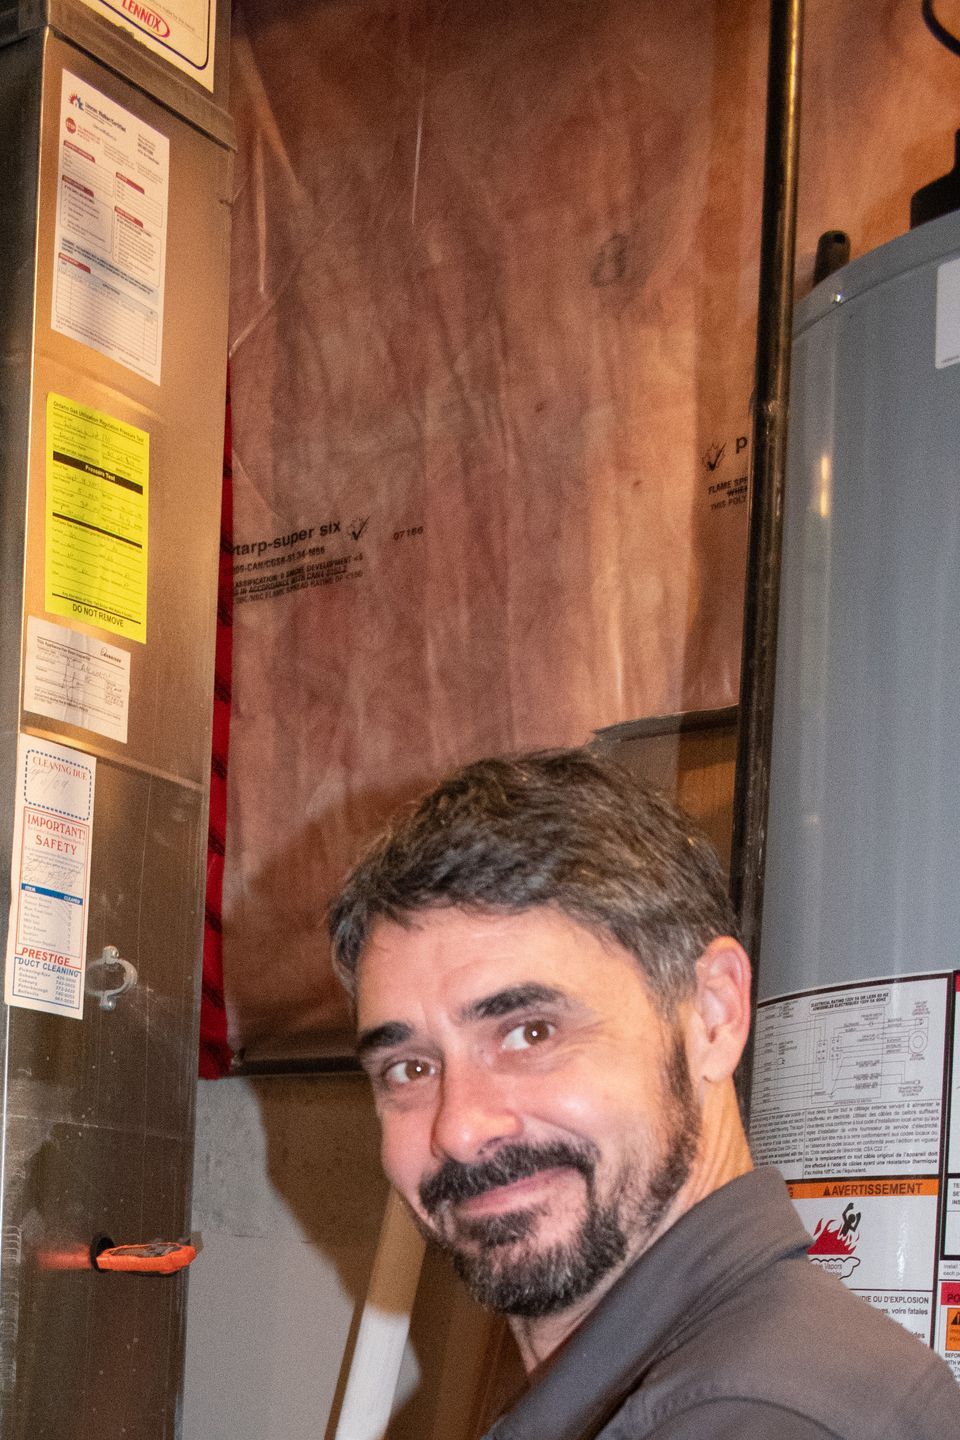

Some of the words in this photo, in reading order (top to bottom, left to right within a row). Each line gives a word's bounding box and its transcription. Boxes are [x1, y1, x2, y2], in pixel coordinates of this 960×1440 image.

[121, 0, 162, 32] LENNOX
[119, 428, 135, 439] Pressure
[320, 521, 340, 534] six
[306, 554, 352, 572] DEVELOPMENT
[72, 604, 82, 613] DO
[83, 607, 98, 618] NOT
[98, 613, 124, 628] REMOVE
[33, 756, 72, 776] CLEANING
[73, 769, 87, 780] DUE
[28, 814, 86, 840] IMPORTANT!
[36, 834, 77, 856] SAFETY
[22, 946, 70, 966] PRESTIGE
[18, 958, 40, 968] DUCT
[42, 962, 79, 977] CLEANING
[832, 1182, 924, 1196] AVERTISSEMENT
[884, 1296, 929, 1304] D'EXPLOSION
